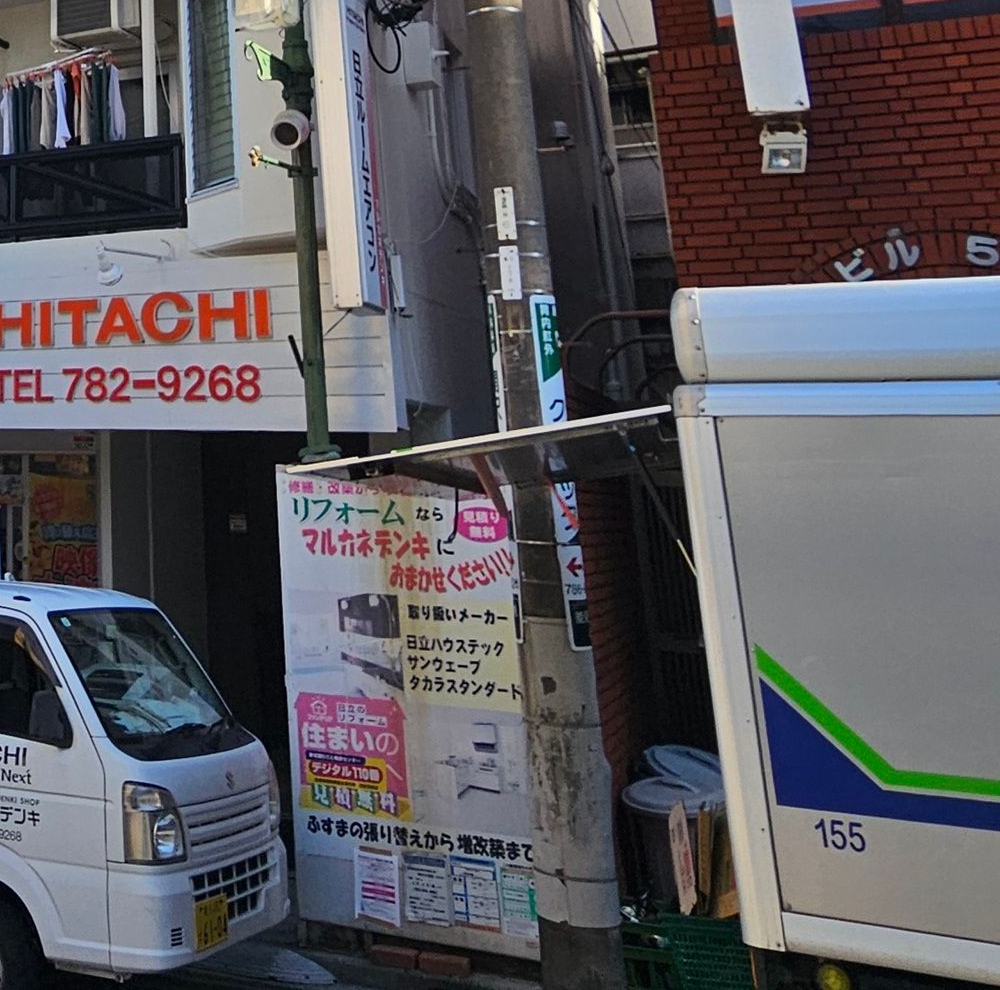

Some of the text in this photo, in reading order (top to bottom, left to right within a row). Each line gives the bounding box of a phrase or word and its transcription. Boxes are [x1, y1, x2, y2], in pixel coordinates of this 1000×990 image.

[834, 235, 999, 282] ビル 5
[62, 363, 263, 404] 782-9268
[291, 496, 445, 526] リフォーム なら
[301, 528, 455, 561] マルカネデンキ に
[407, 604, 508, 625] 取り扱いメーカー
[406, 634, 504, 657] 日立ハウステック
[409, 674, 524, 700] タカラスタンダード
[338, 714, 386, 726] リフォーム
[301, 721, 400, 756] 住まいの
[1, 768, 32, 785] Next
[20, 797, 40, 807] SHOP
[307, 815, 454, 852] ふすまの張り替えから
[814, 818, 867, 853] 155
